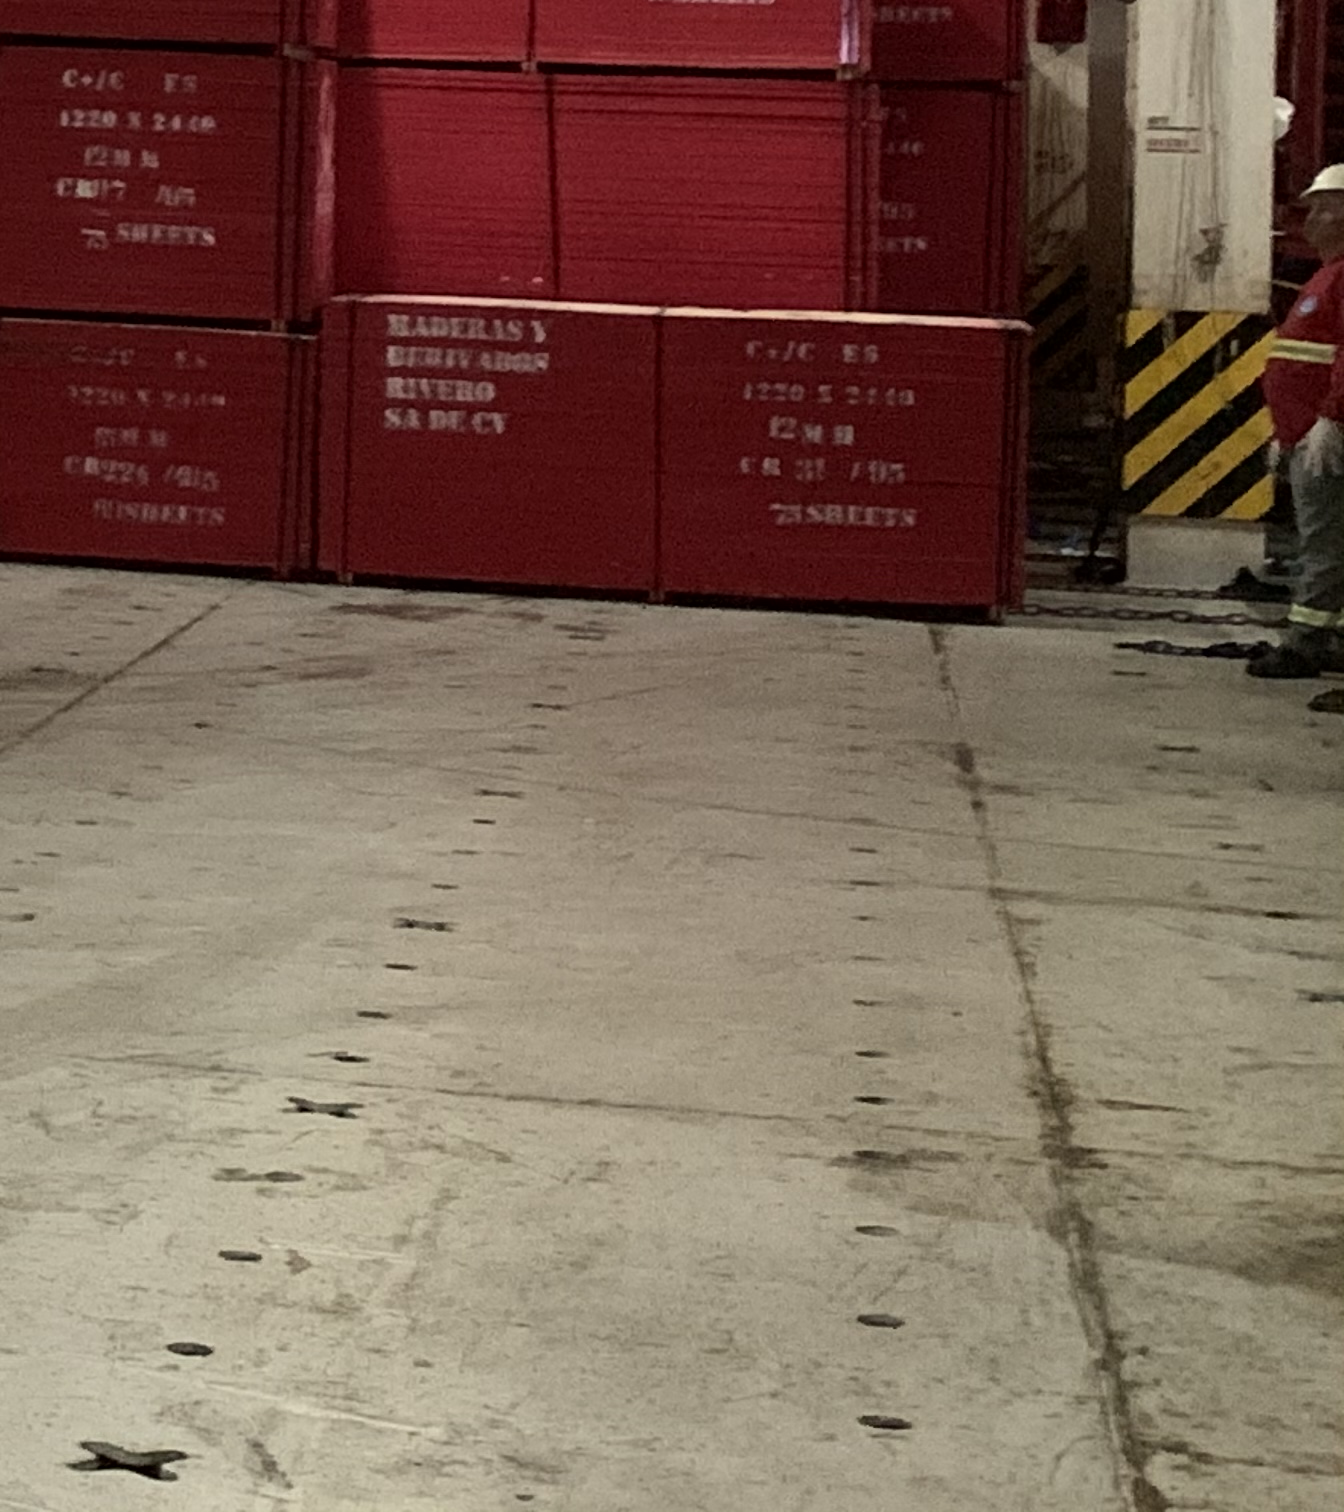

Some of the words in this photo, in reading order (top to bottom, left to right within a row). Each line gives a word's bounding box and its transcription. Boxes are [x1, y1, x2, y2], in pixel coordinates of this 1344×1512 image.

[62, 69, 125, 91] C+/C
[164, 72, 198, 94] ES
[60, 109, 117, 129] 1220
[127, 110, 142, 131] X
[152, 111, 217, 135] 2440
[385, 314, 525, 341] MADERAS
[529, 319, 549, 343] Y
[385, 345, 550, 374] DERIVADOS
[745, 340, 815, 362] C+/C
[842, 343, 879, 364] ES
[385, 376, 496, 402] RIVERO
[743, 382, 805, 402] 1220
[817, 384, 833, 404] X
[845, 385, 915, 407] 2440
[383, 407, 424, 431] SA
[427, 408, 468, 433] DE
[470, 410, 512, 435] CV
